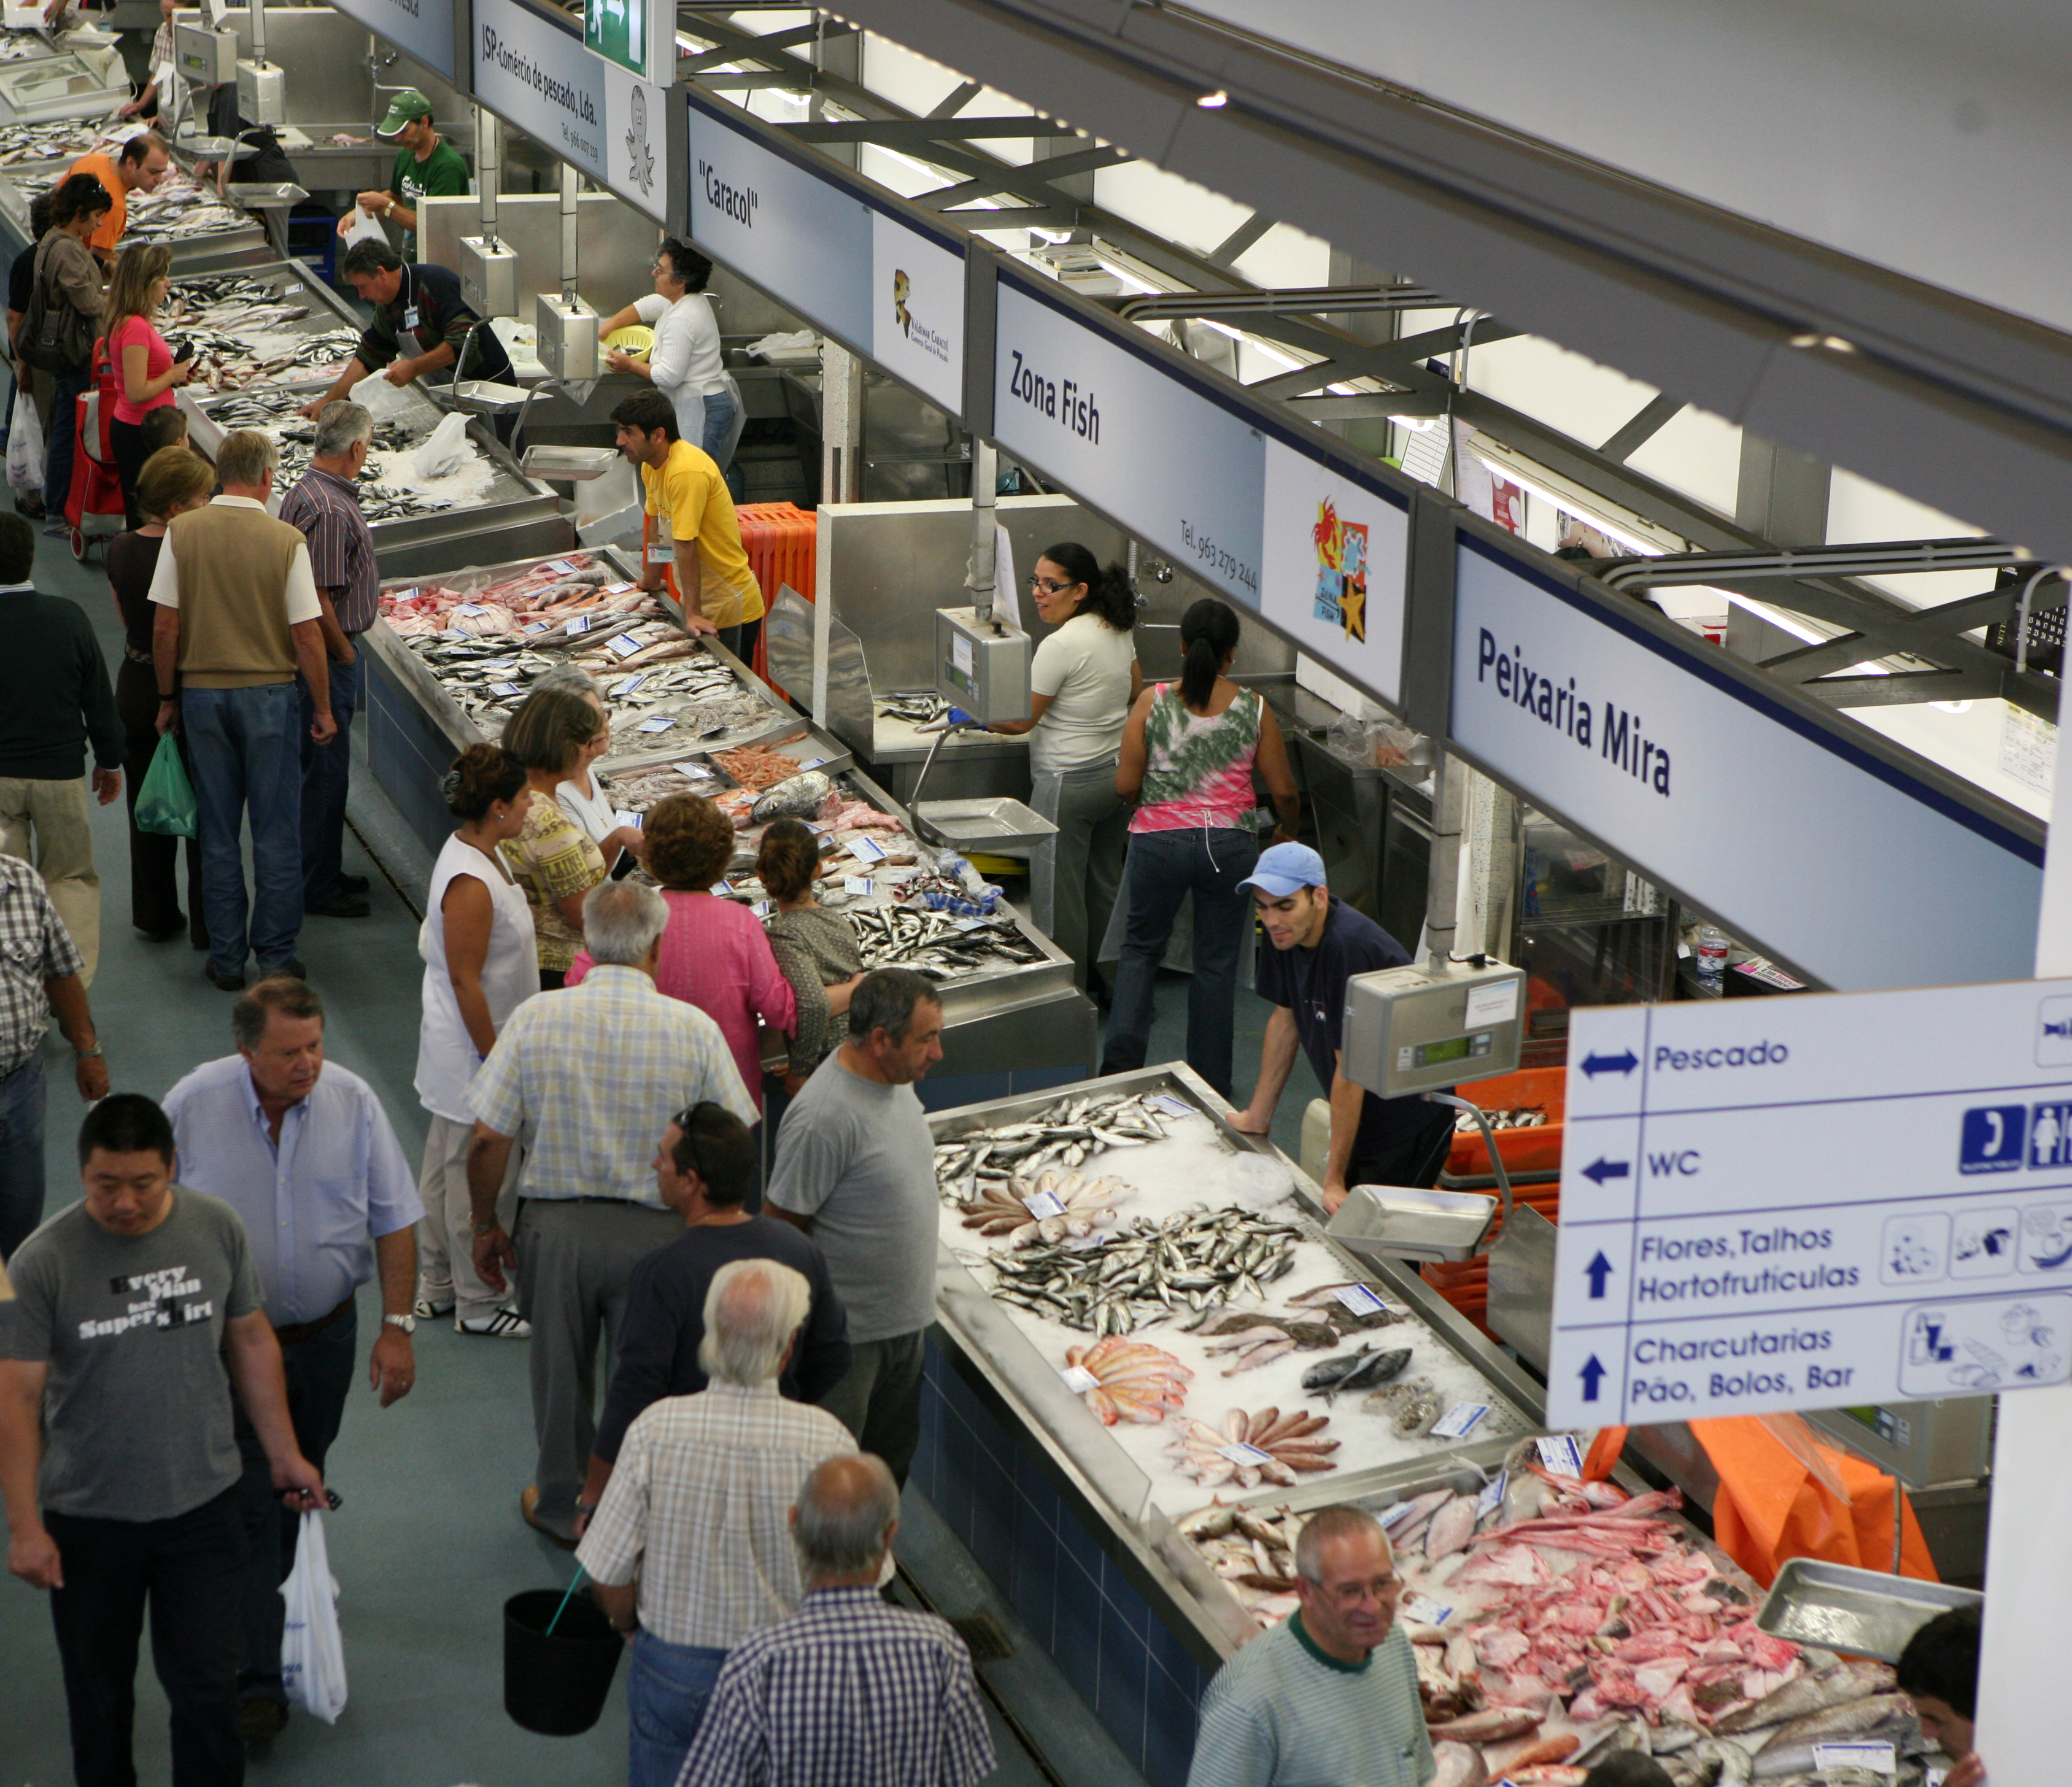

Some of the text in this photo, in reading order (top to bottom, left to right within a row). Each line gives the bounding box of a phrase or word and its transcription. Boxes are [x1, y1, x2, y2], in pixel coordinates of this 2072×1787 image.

[532, 61, 542, 92] de
[543, 75, 578, 119] pescado,
[579, 90, 597, 126] Lda.
[561, 122, 598, 163] Tel. 966 007 119
[699, 159, 758, 229] "Caracol"
[1010, 349, 1100, 446] Zona Fish
[1180, 519, 1257, 595] Tel. 963 279 244
[1477, 626, 1670, 798] Peixaria Mira
[1654, 1040, 1789, 1072] Pescado
[1648, 1149, 1701, 1178] WC
[148, 1277, 202, 1302] Man
[79, 1309, 157, 1340] Super
[1634, 1327, 1832, 1365] Charcutarias
[1631, 1364, 1855, 1405] Pão, Bolos, Bar
